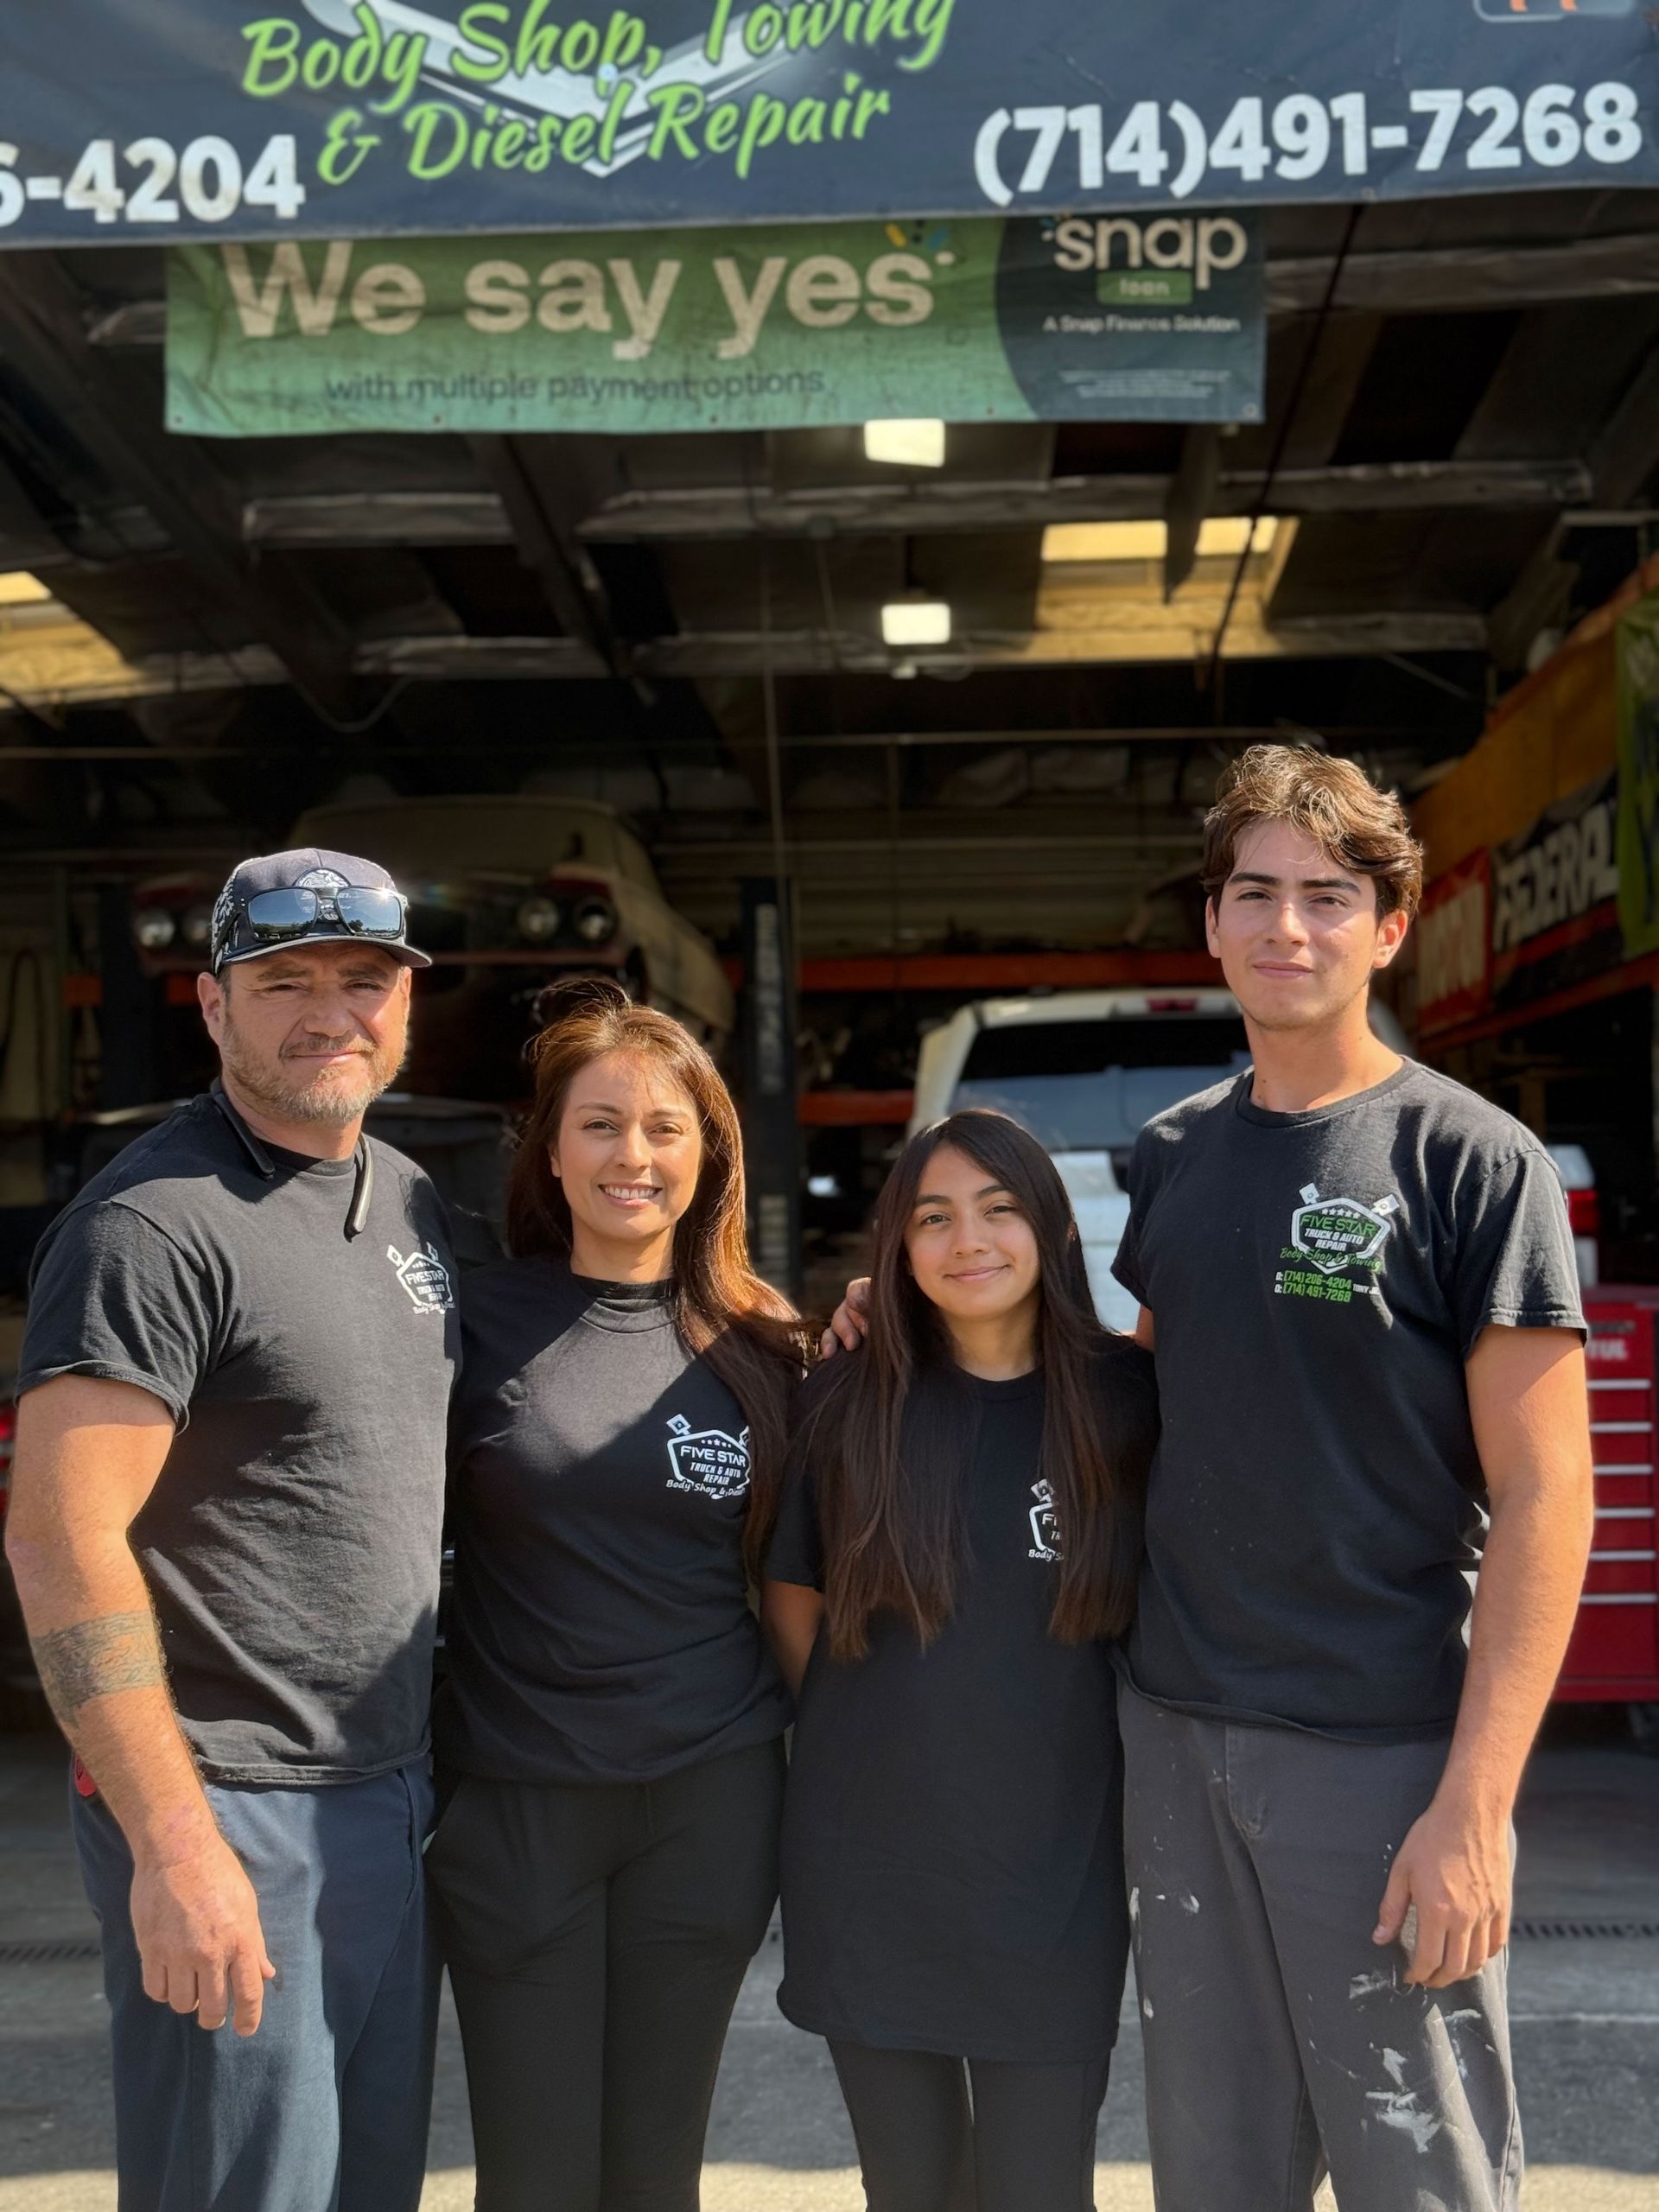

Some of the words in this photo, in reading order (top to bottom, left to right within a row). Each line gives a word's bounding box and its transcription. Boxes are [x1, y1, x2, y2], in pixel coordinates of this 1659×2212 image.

[242, 0, 428, 114] Body
[449, 0, 663, 99] Shop,
[317, 108, 381, 185] &
[403, 81, 636, 181] Diesel
[645, 73, 891, 180] Repair
[974, 82, 1643, 207] (714)491-7268
[1053, 218, 1249, 291] snap
[220, 240, 427, 336] We
[464, 258, 682, 360] say
[326, 372, 397, 401] with
[408, 372, 537, 405] multiple
[548, 373, 693, 405] payment
[702, 370, 825, 401] options
[1300, 1214, 1335, 1230] FIVE
[1335, 1217, 1377, 1236] STAR
[1304, 1228, 1332, 1240] TRUCK
[1339, 1233, 1364, 1245] AUTO
[1315, 1239, 1347, 1252] REPAIR
[1280, 1247, 1306, 1262] Body
[1306, 1249, 1333, 1266] Shop
[680, 1445, 715, 1461] FIVE
[717, 1451, 746, 1467] STAR
[690, 1462, 716, 1474] TRUCK
[724, 1467, 741, 1478] AUTO
[703, 1473, 730, 1485] REPAIR
[666, 1479, 691, 1491] Body
[694, 1483, 716, 1496] Shop
[1028, 1549, 1052, 1562] Body
